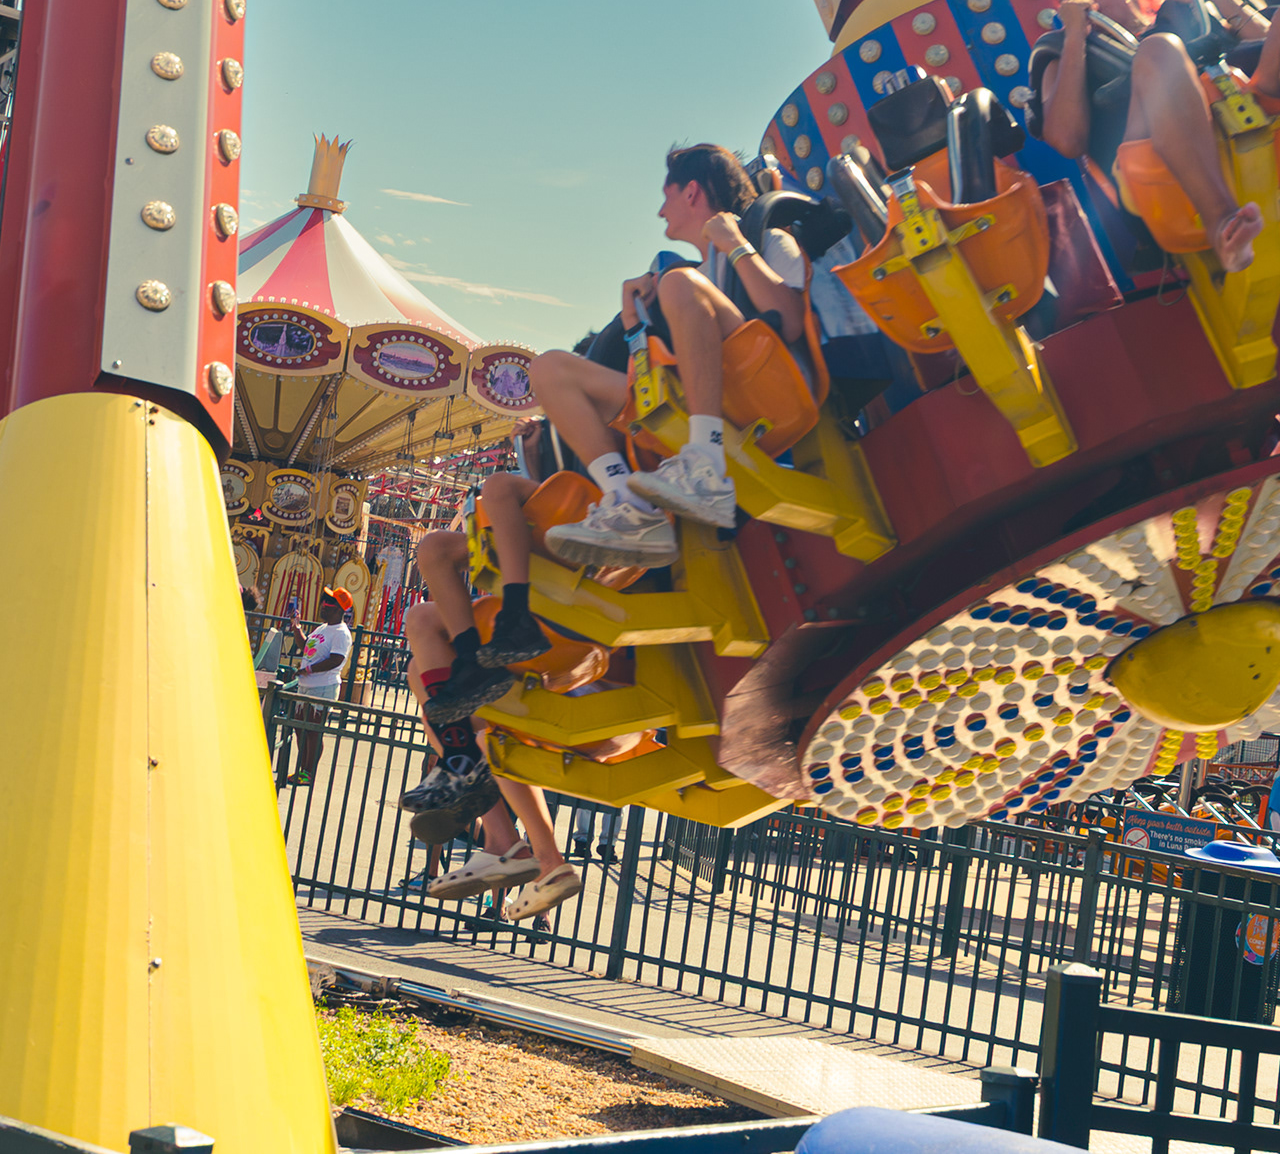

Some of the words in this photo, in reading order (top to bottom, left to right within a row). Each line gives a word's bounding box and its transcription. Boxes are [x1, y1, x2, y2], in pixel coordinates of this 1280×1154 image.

[1150, 830, 1173, 841] There's
[1174, 834, 1183, 843] no
[1185, 836, 1209, 847] smokin
[1159, 839, 1166, 848] in
[1167, 841, 1183, 851] Luna
